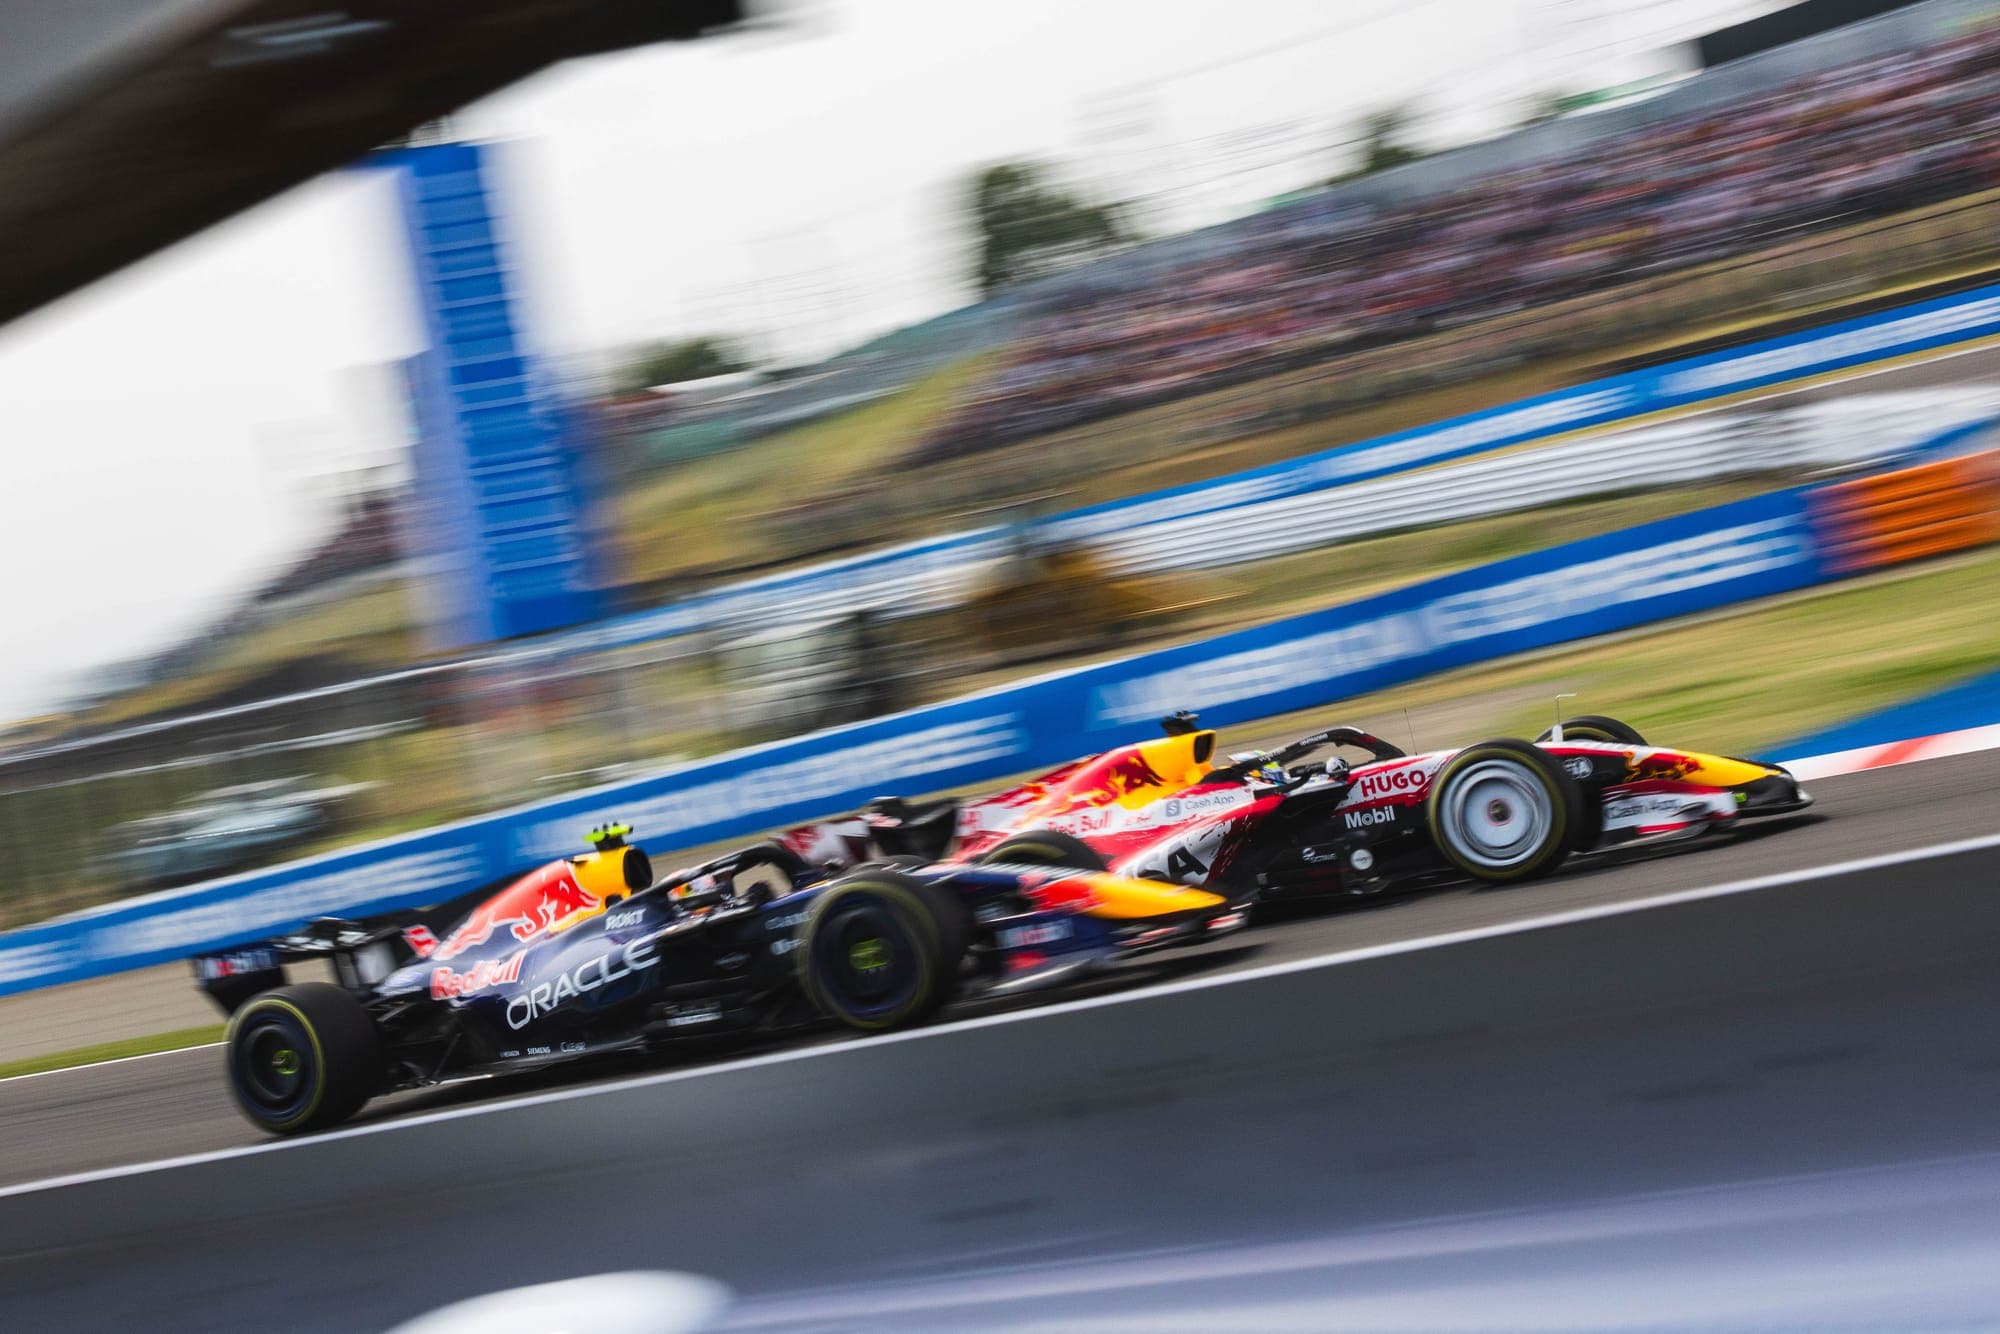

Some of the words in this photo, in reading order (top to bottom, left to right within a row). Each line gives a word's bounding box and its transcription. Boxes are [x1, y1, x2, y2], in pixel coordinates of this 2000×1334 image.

[1360, 770, 1426, 798] HUGO
[1344, 805, 1396, 829] Mobil
[506, 938, 661, 1030] ORACLE
